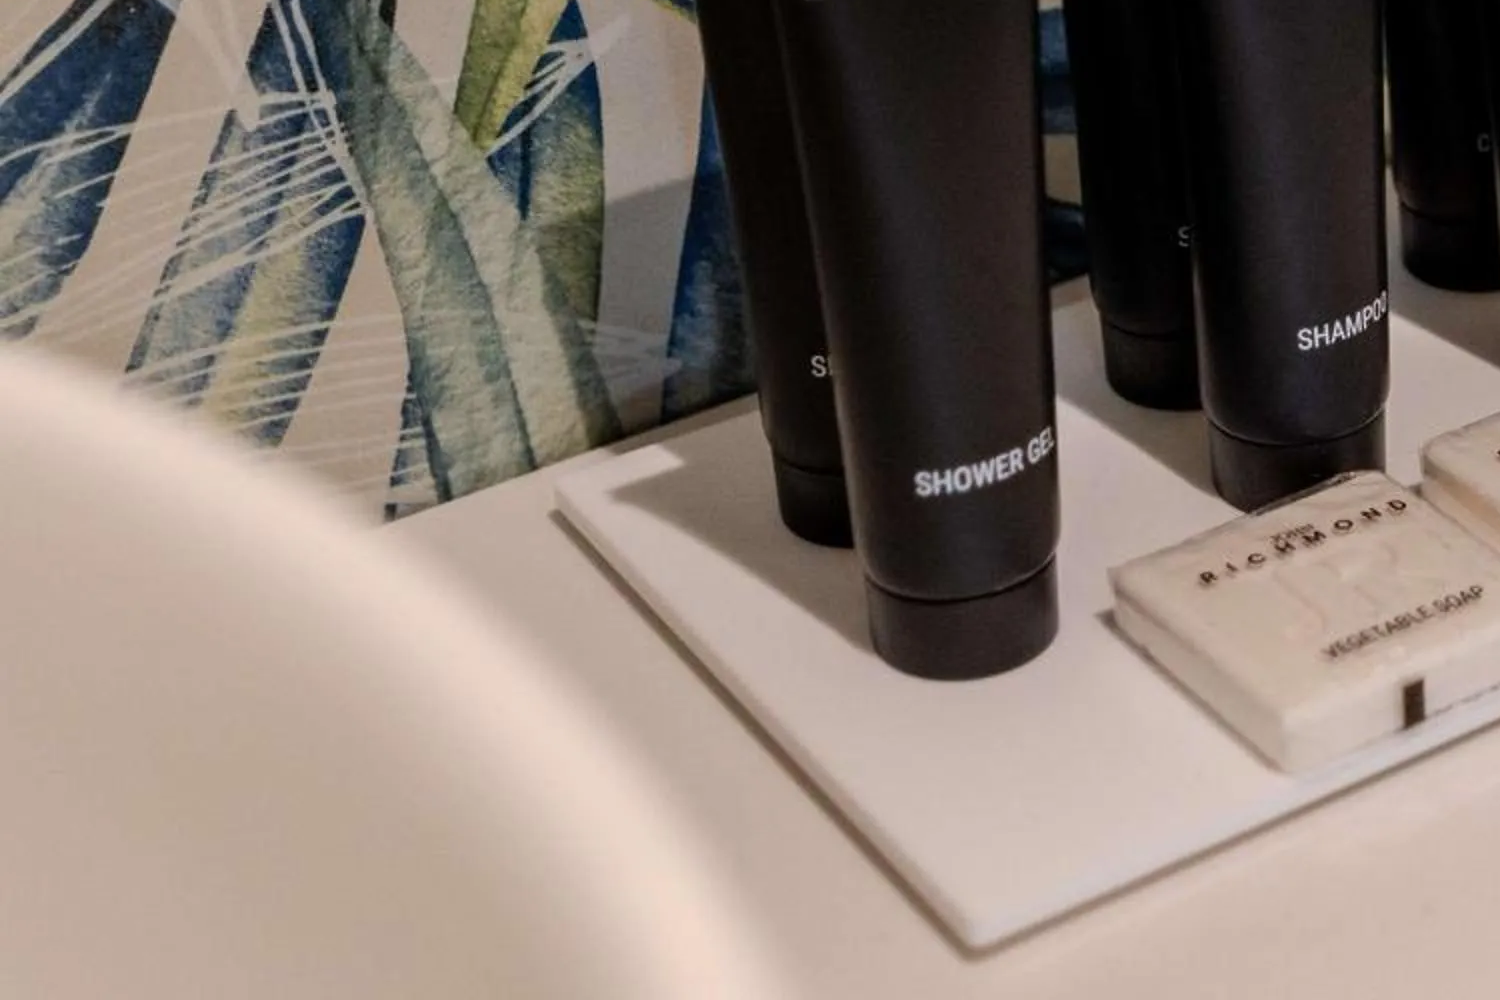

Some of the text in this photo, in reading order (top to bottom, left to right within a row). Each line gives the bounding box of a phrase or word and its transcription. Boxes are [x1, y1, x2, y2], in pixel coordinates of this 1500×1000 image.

[913, 447, 1025, 498] SHOWER
[1199, 499, 1407, 586] RICHMOND
[1322, 584, 1484, 660] VEGETABLE SOAP
